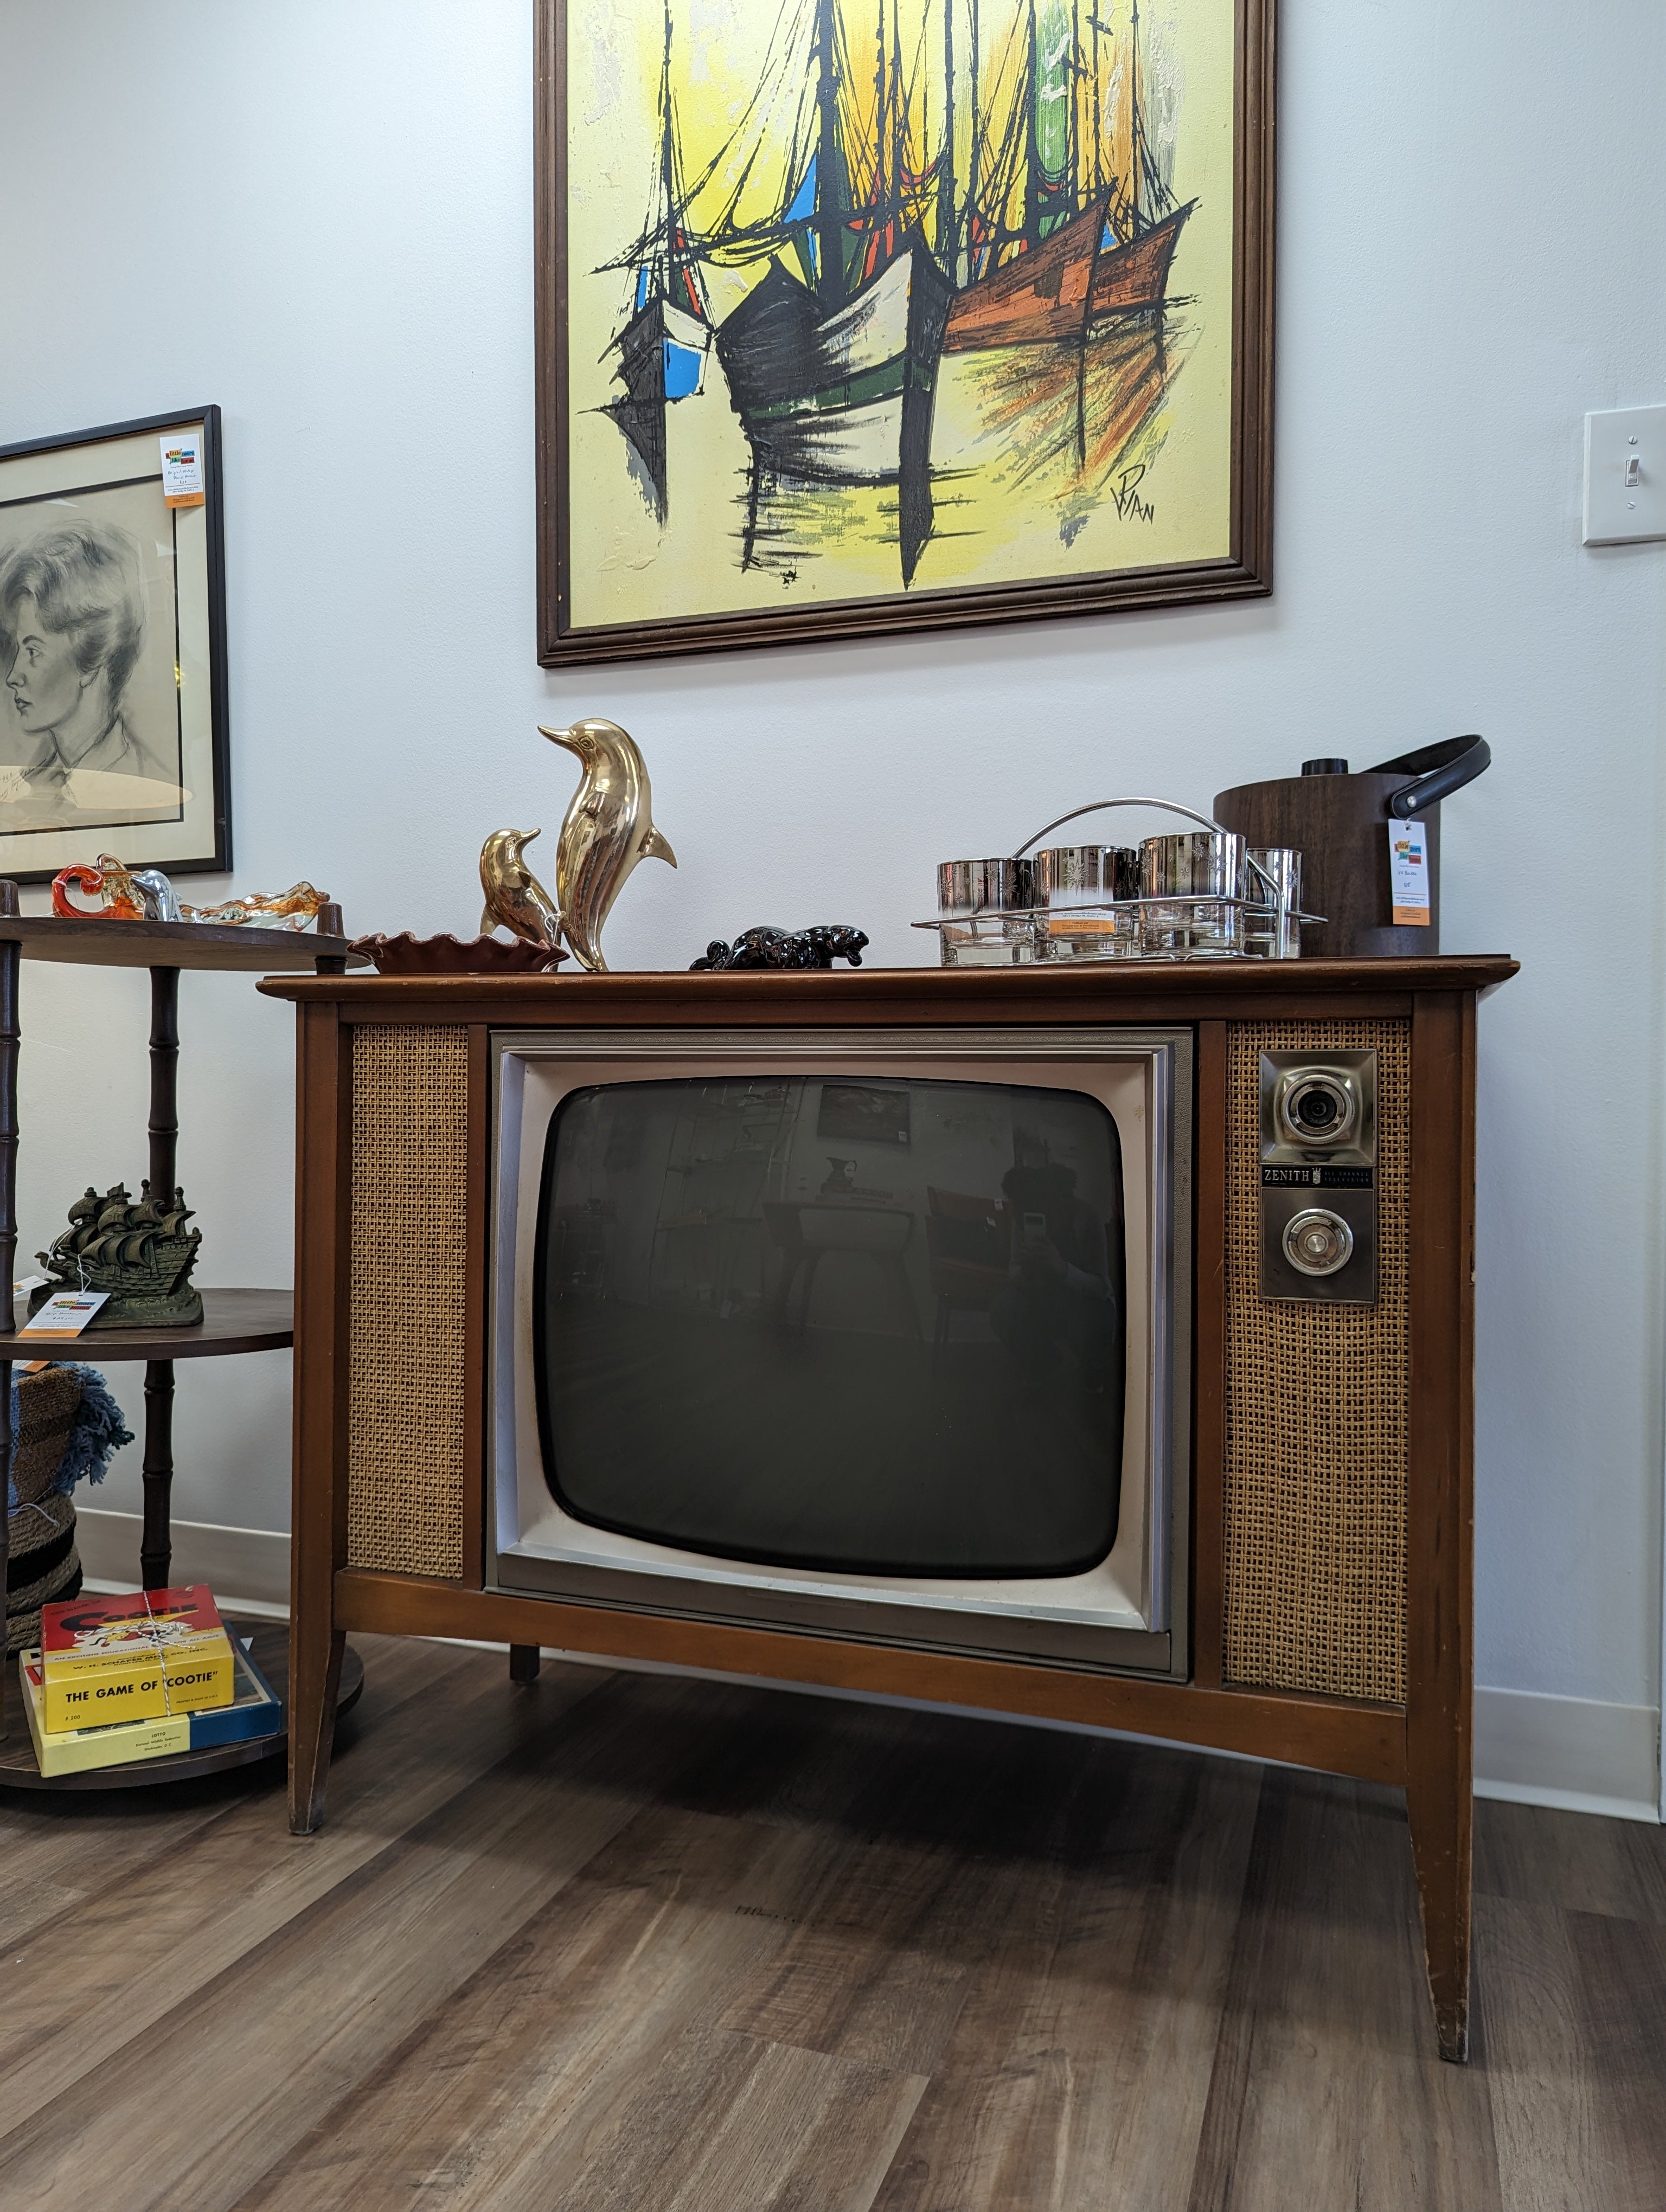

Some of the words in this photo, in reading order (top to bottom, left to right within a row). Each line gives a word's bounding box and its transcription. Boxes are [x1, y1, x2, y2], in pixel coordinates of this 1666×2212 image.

[1264, 1169, 1310, 1181] ZENITH
[60, 1603, 198, 1631] COOTIE
[101, 1645, 149, 1655] EDUCATIONAL
[101, 1656, 143, 1666] SCHAPER
[66, 1691, 89, 1703] THE
[96, 1684, 134, 1699] GAME
[141, 1680, 158, 1692] OF
